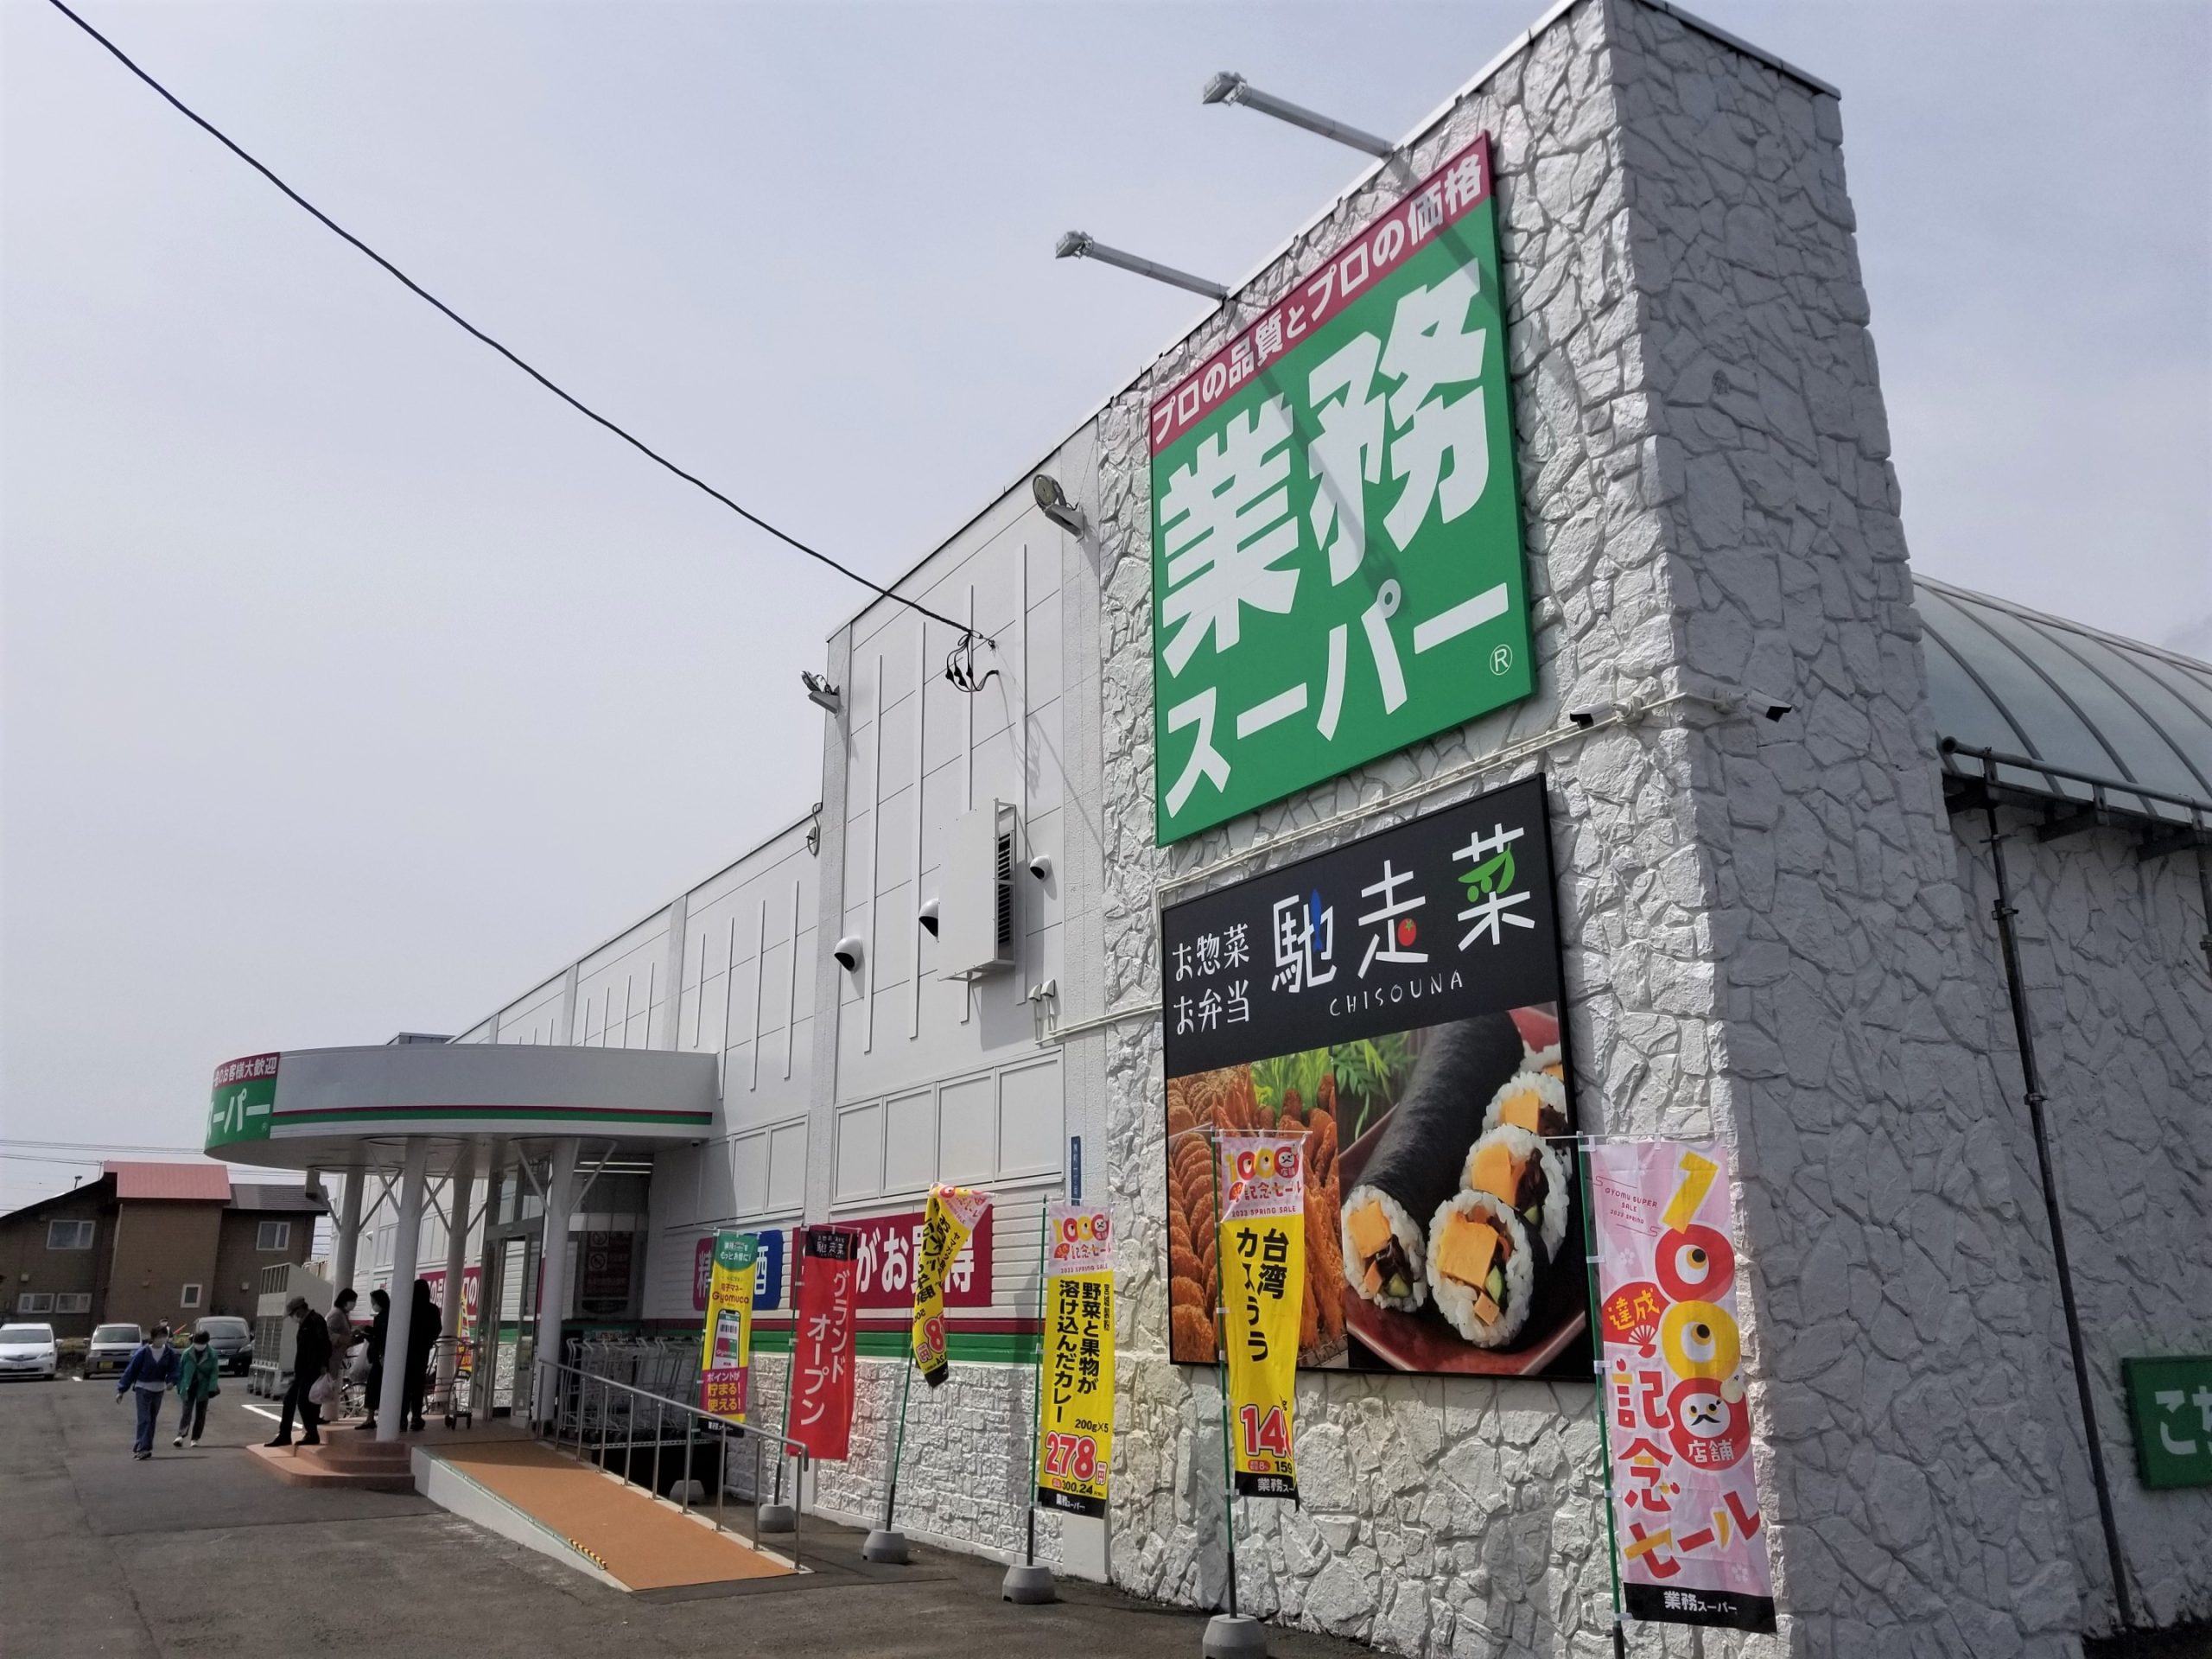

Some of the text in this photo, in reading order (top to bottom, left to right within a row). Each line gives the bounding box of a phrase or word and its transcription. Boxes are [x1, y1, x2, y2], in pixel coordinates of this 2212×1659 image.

[1154, 153, 1481, 445] プロの品質とプロの価格
[1160, 257, 1491, 678] 業務
[1165, 579, 1509, 819] スーパー
[1272, 823, 1536, 994] 馳走菜
[1172, 923, 1250, 982] お惣菜
[1173, 979, 1250, 1036] お弁当
[1329, 969, 1464, 1018] CHISOUNA
[1279, 1205, 1296, 1214] SALE
[1621, 1202, 1637, 1212] SALE
[1632, 1196, 1658, 1209] SUPER
[1257, 1227, 1289, 1300] 台湾
[831, 1268, 850, 1383] グランド
[1077, 1281, 1102, 1395] 野菜と果物が
[1608, 1287, 1661, 1331] 達成
[707, 1370, 741, 1383] ポイントが
[800, 1313, 831, 1426] オープン
[1053, 1279, 1080, 1423] 溶け込んだカレー
[1044, 1429, 1097, 1482] 278
[1688, 1439, 1735, 1464] 店舗
[1663, 1590, 1738, 1613] 業務スーパー
